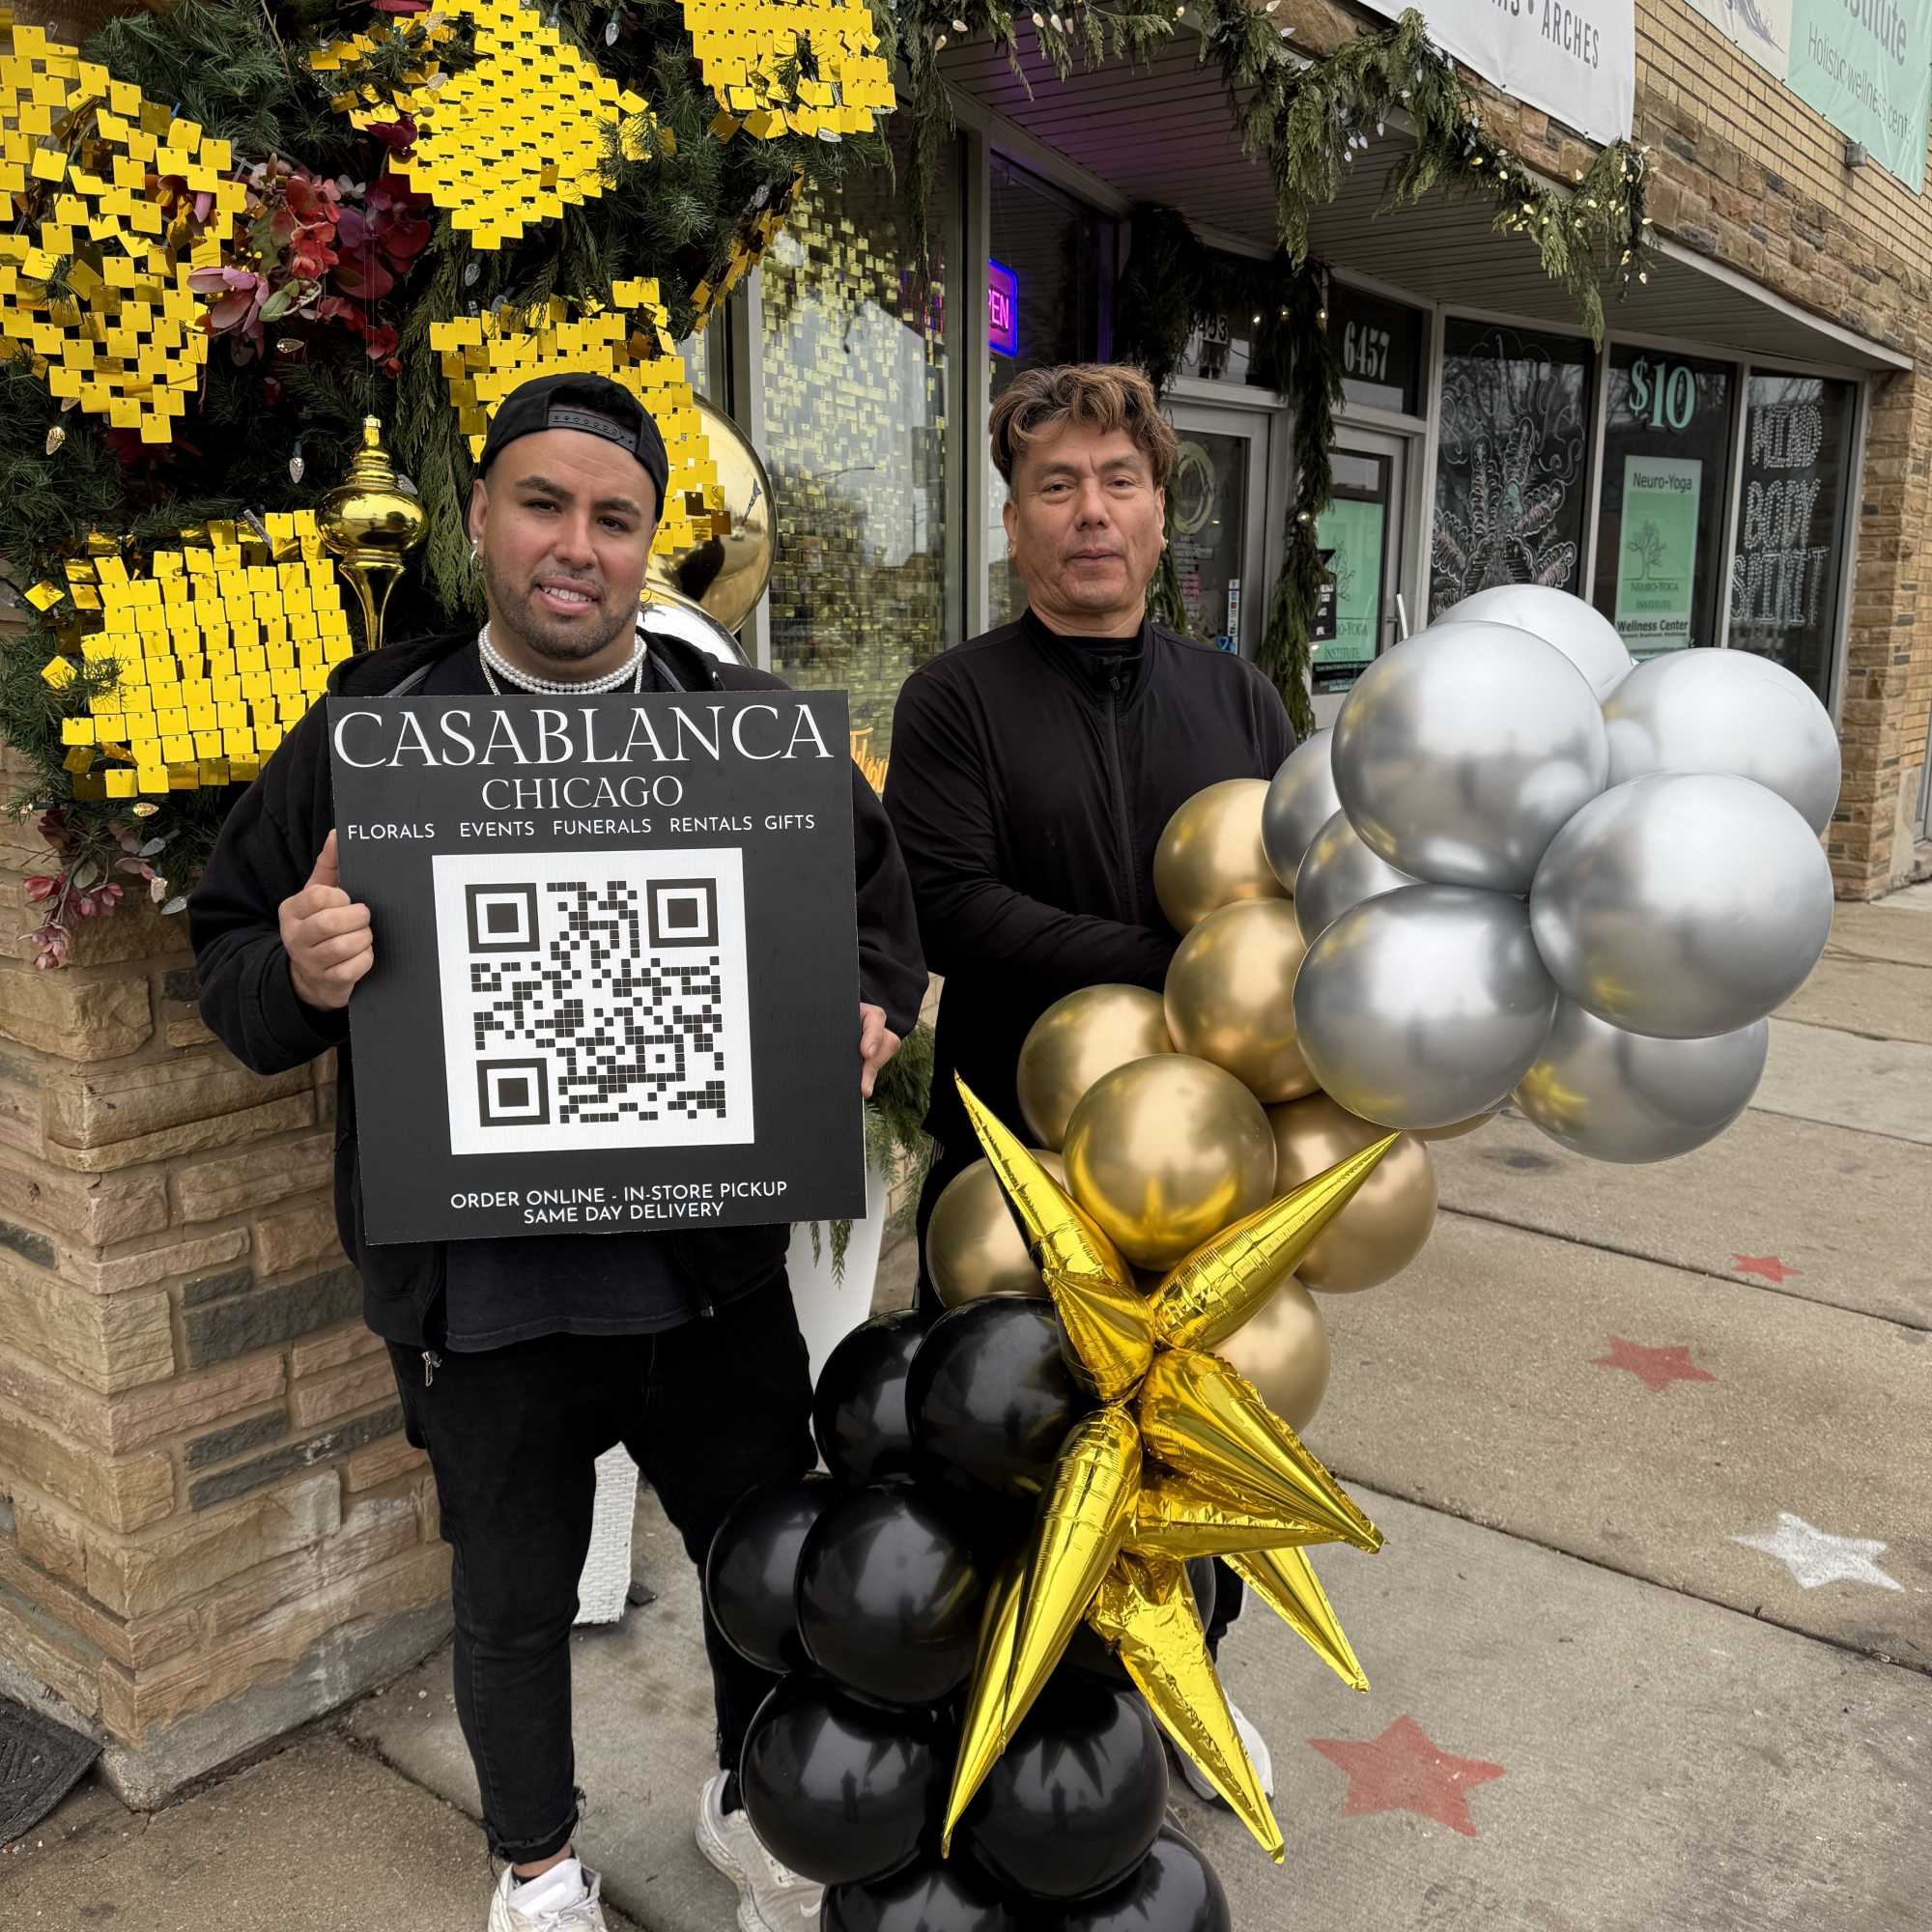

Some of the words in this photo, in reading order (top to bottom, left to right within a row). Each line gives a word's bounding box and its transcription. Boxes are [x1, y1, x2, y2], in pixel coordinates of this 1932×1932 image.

[1542, 0, 1600, 70] ARCHES
[1808, 20, 1847, 85] Holistic
[1847, 63, 1886, 122] wellness
[1344, 321, 1390, 382] 6457
[1628, 356, 1697, 429] $10
[1633, 471, 1692, 494] Neuro-Yoga
[1617, 619, 1658, 632] Wellness
[1660, 619, 1689, 631] Center
[334, 704, 835, 768] CASABLANCA
[482, 776, 683, 810] CHICAGO
[348, 823, 435, 840] FLORALS
[460, 820, 535, 838] EVENTS
[553, 818, 652, 836] FUNERALS
[669, 815, 753, 833] RENTALS
[764, 813, 815, 830] GIFTS
[450, 1191, 520, 1209] ORDER
[526, 1187, 603, 1206] ONLINE
[624, 1183, 713, 1202] IN-STORE
[720, 1180, 787, 1199] PICKUP
[524, 1207, 579, 1225] SAME
[585, 1205, 623, 1223] DAY
[630, 1201, 724, 1220] DELIVERY
